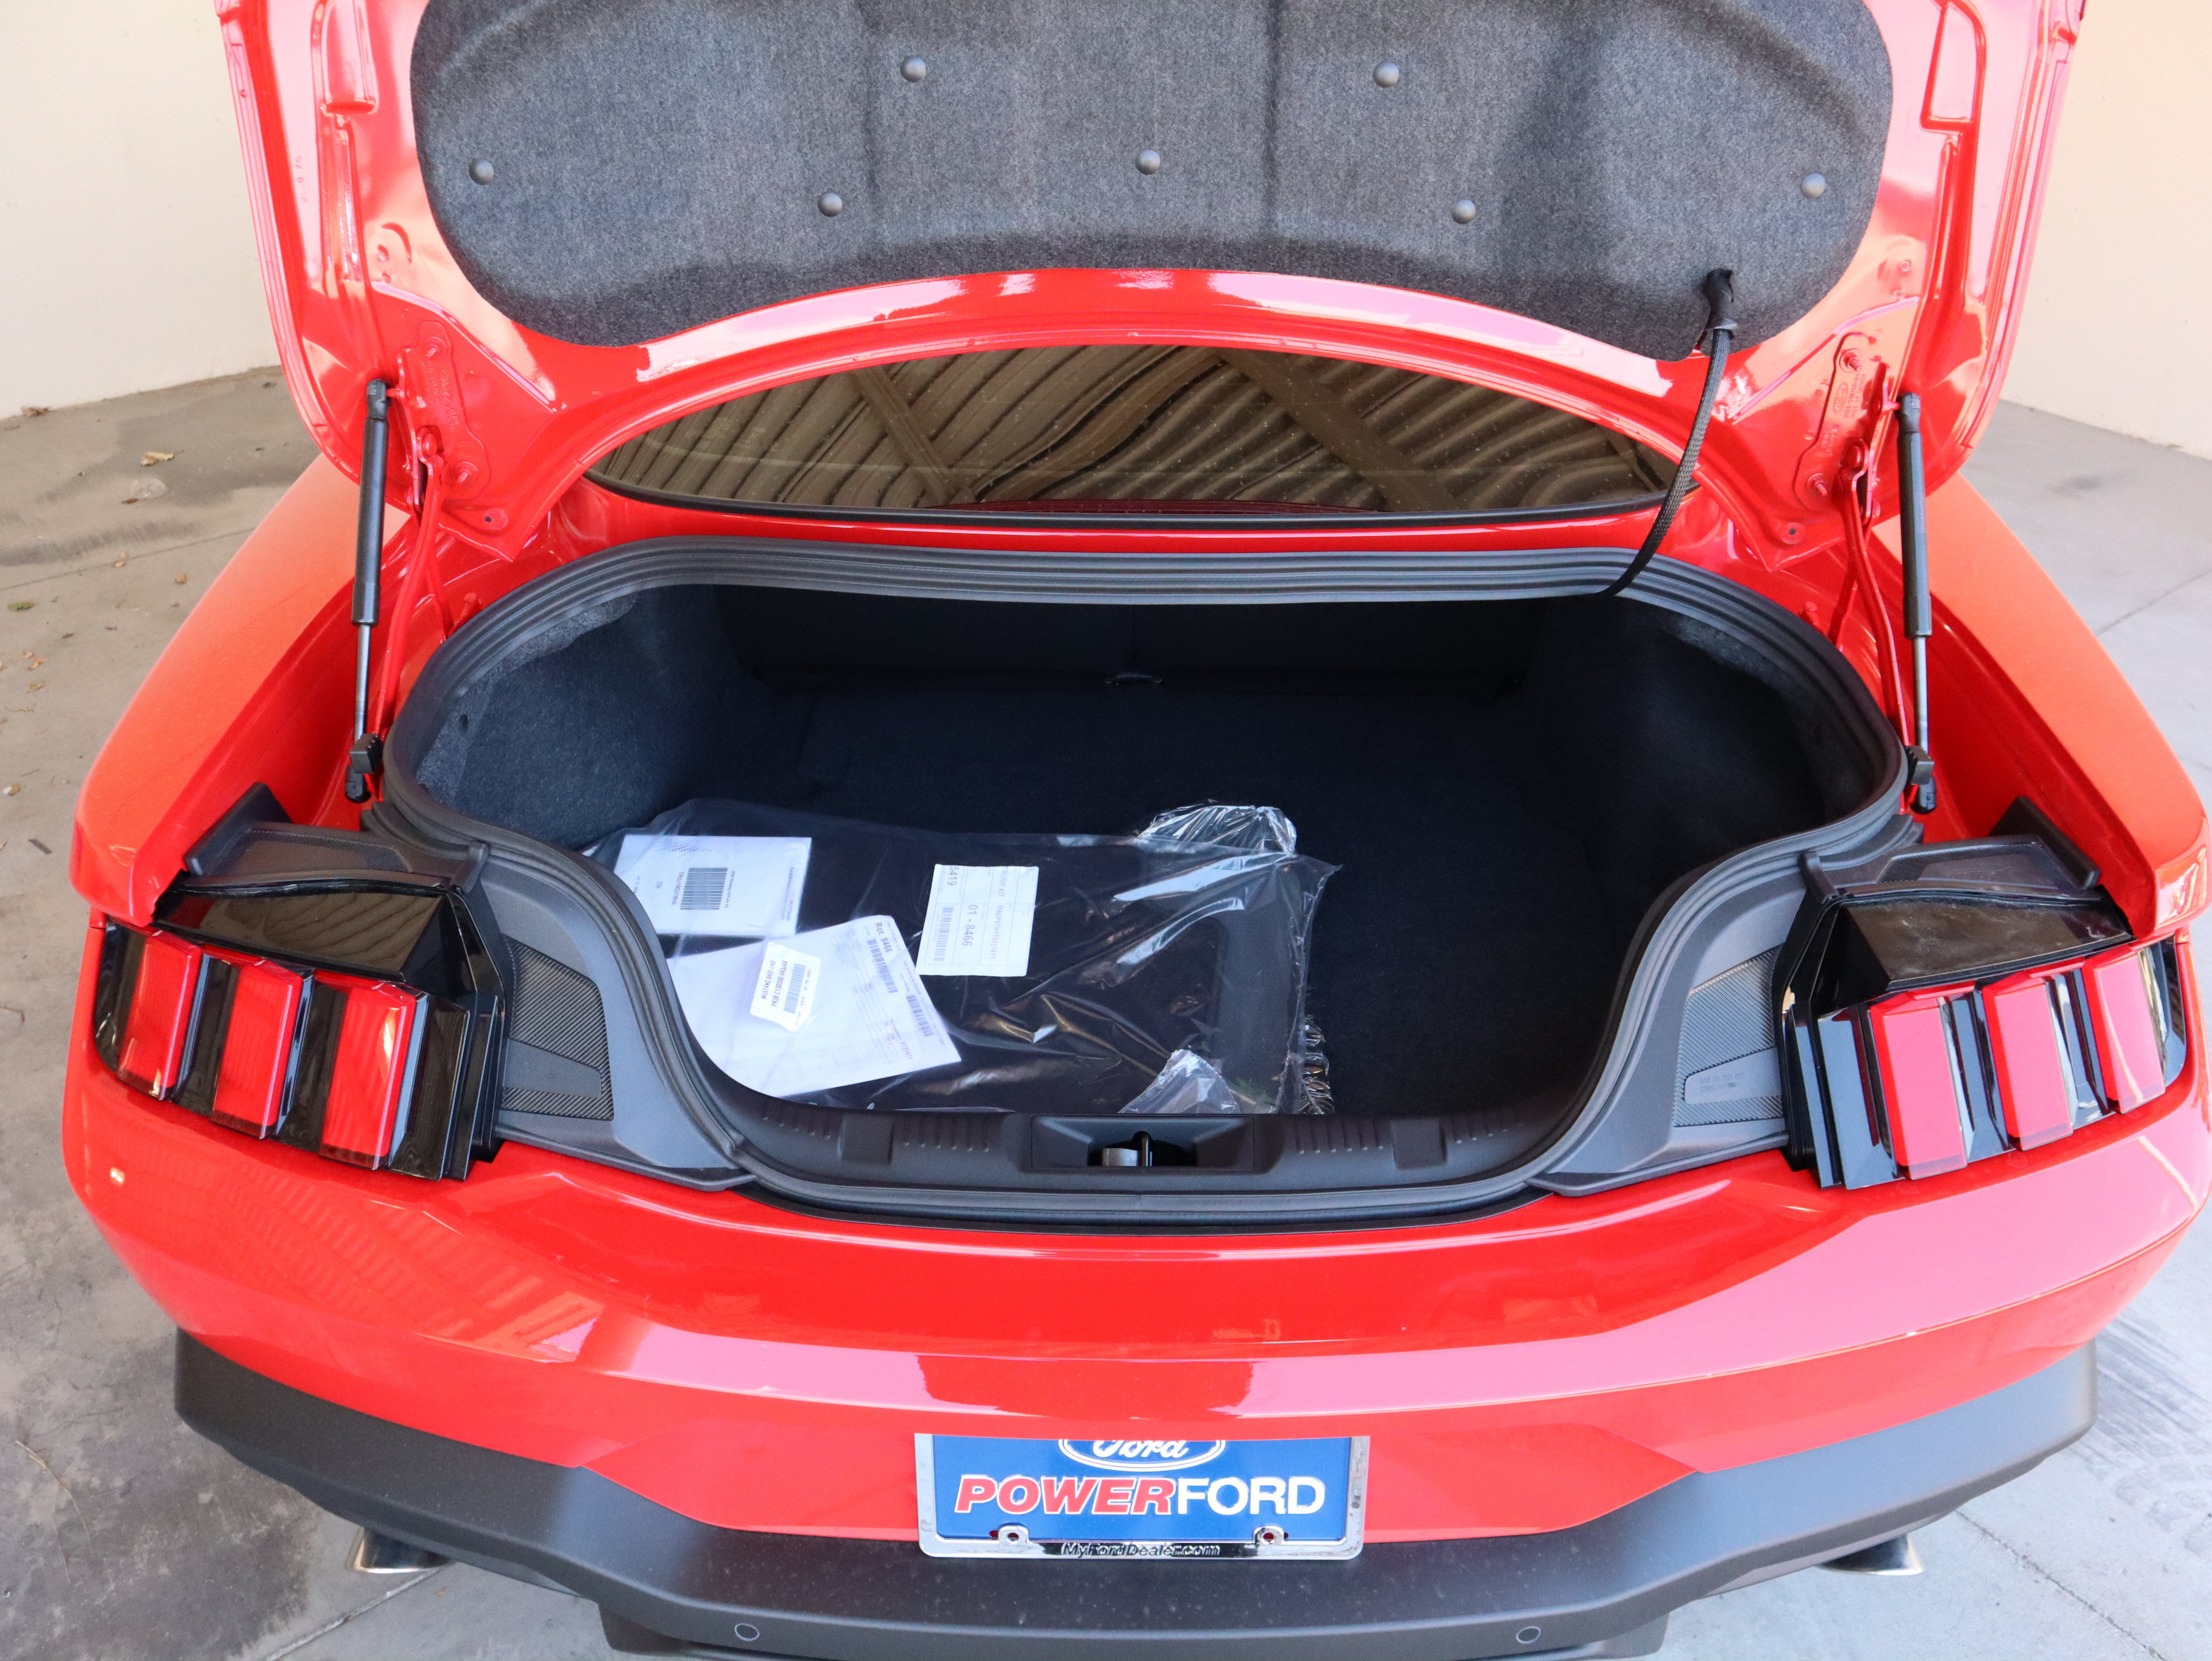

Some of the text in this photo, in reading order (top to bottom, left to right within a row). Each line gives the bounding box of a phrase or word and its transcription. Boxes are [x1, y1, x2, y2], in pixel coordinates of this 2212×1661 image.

[947, 866, 959, 886] 5419
[999, 866, 1008, 886] TRUNK
[968, 905, 978, 915] 01
[875, 922, 893, 953] Rot: 8466
[962, 924, 975, 946] 8466
[761, 979, 771, 999] MUSTANG
[900, 1041, 913, 1059] 5131411
[954, 1475, 1326, 1515] POWERFORD
[1061, 1542, 1221, 1558] MyFordDealer.com
